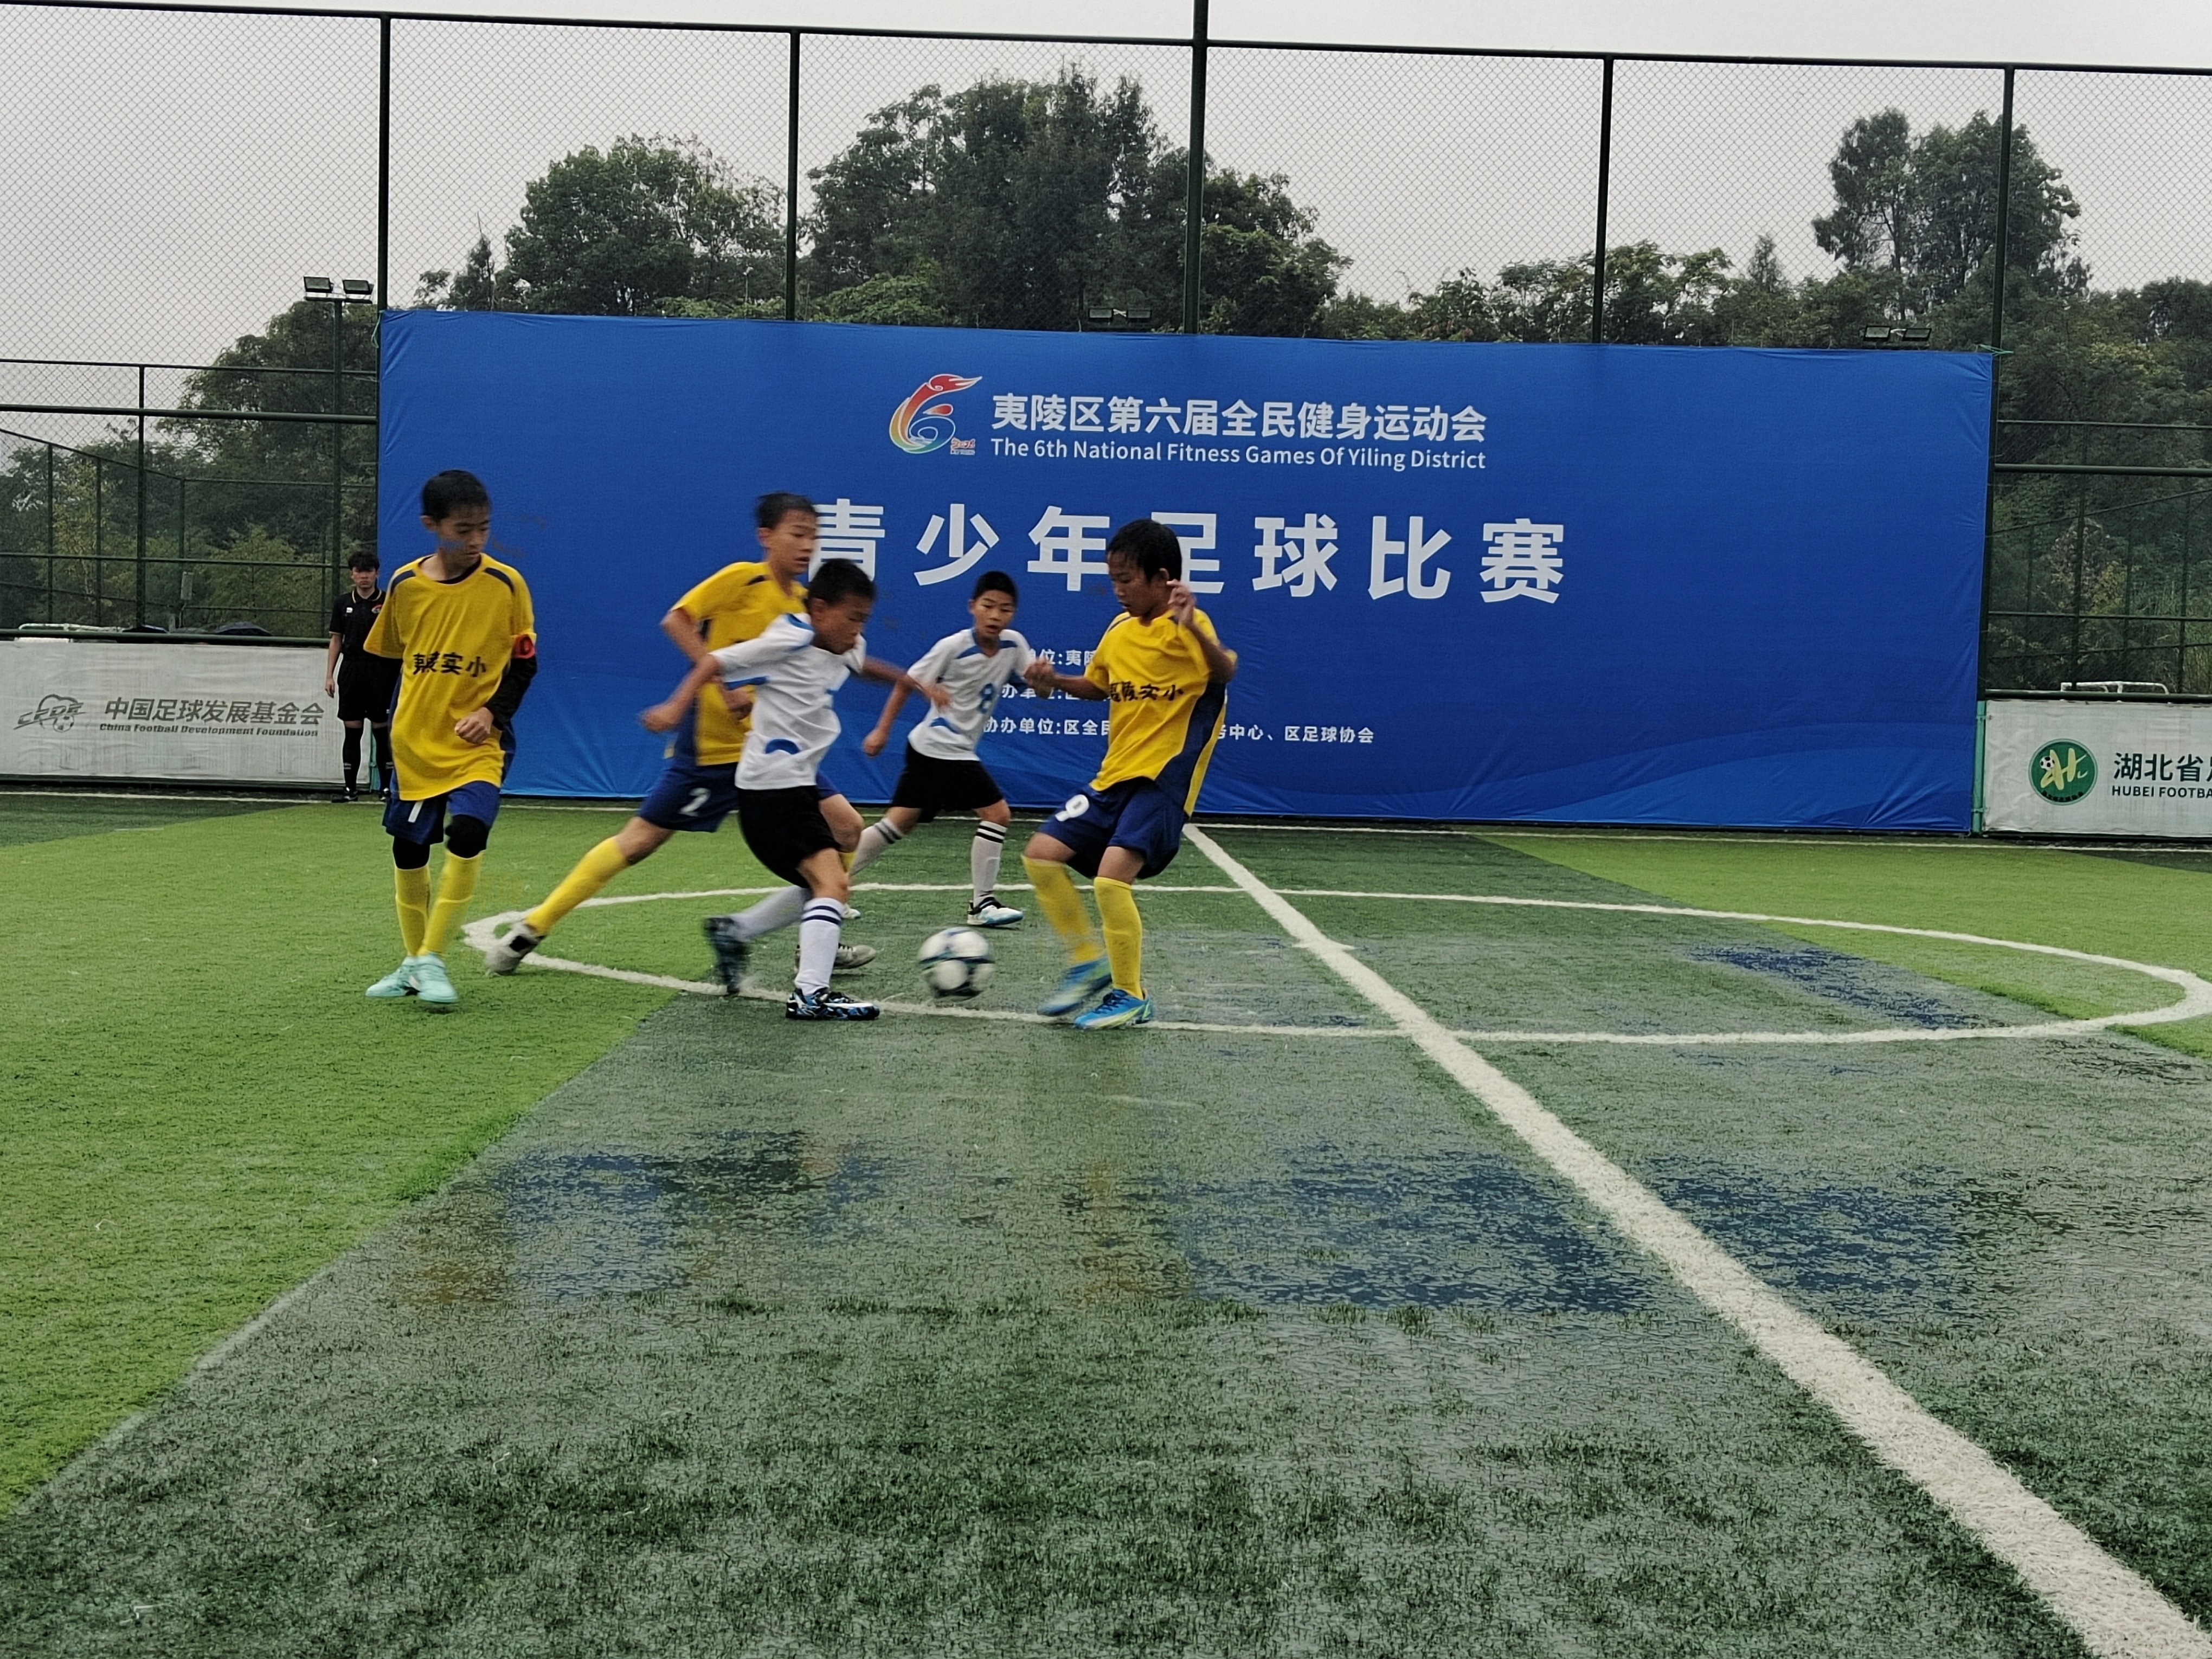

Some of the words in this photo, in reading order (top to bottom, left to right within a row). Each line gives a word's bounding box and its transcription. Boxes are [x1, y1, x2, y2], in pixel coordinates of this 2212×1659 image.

[991, 393, 1487, 442] 夷陵区第六届全民健身运动会
[991, 438, 1029, 457] The
[1034, 439, 1068, 458] 6th
[1073, 441, 1161, 461] National
[1167, 442, 1240, 462] Fitness
[1246, 446, 1315, 465] Games
[1320, 446, 1345, 465] Of
[1348, 447, 1406, 472] Yiling
[1411, 449, 1486, 469] District
[105, 697, 325, 725] 中国足球发展基金会
[979, 683, 994, 713] 8
[100, 723, 131, 732] China
[134, 724, 179, 733] Football
[181, 725, 254, 735] Development
[256, 727, 318, 737] Foundation
[2113, 753, 2212, 782] 湖北省
[679, 787, 711, 817] 2
[2112, 785, 2155, 798] HUBEI
